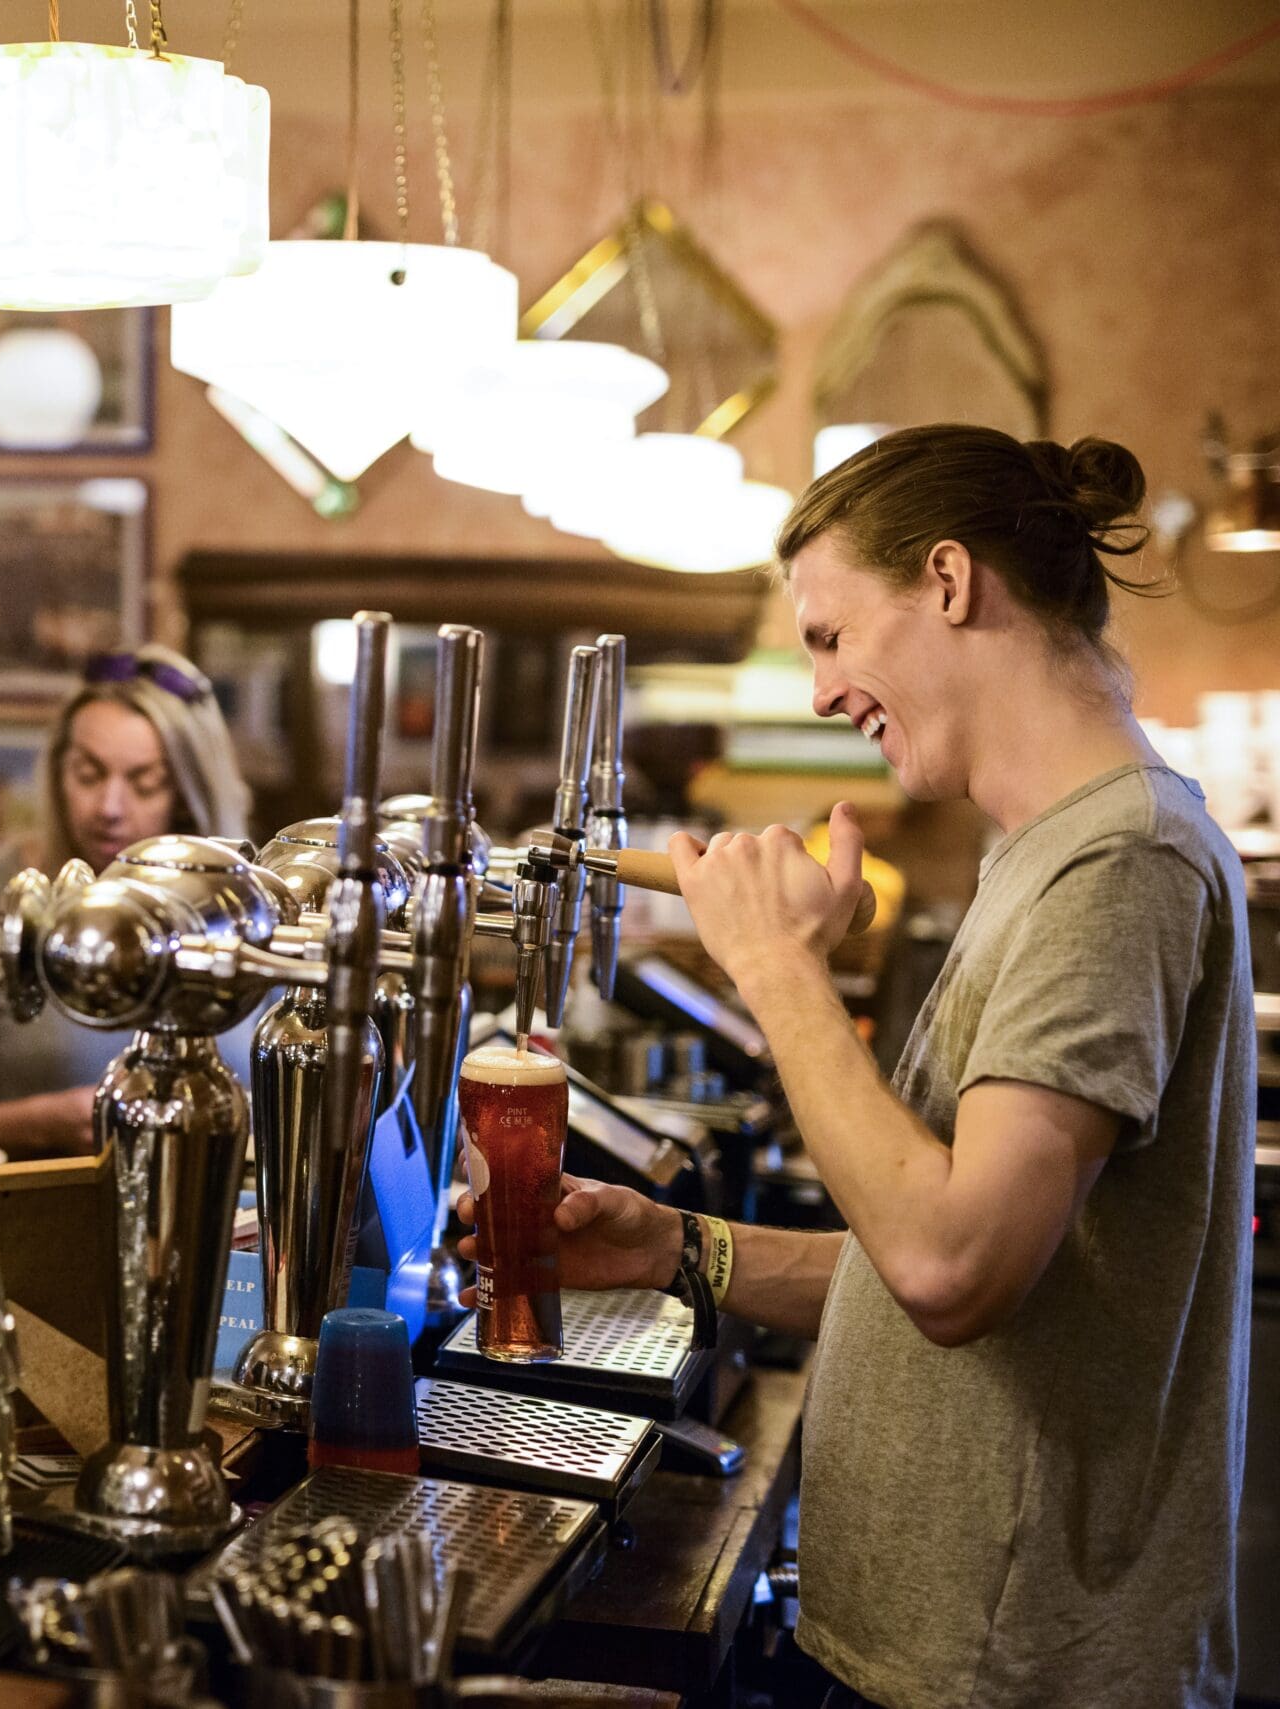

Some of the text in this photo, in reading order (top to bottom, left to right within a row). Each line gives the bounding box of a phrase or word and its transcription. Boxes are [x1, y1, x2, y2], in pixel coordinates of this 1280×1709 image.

[507, 1107, 528, 1116] PINT
[712, 1238, 728, 1288] OXJAM
[225, 1279, 256, 1293] ELP
[219, 1316, 258, 1330] PEAL
